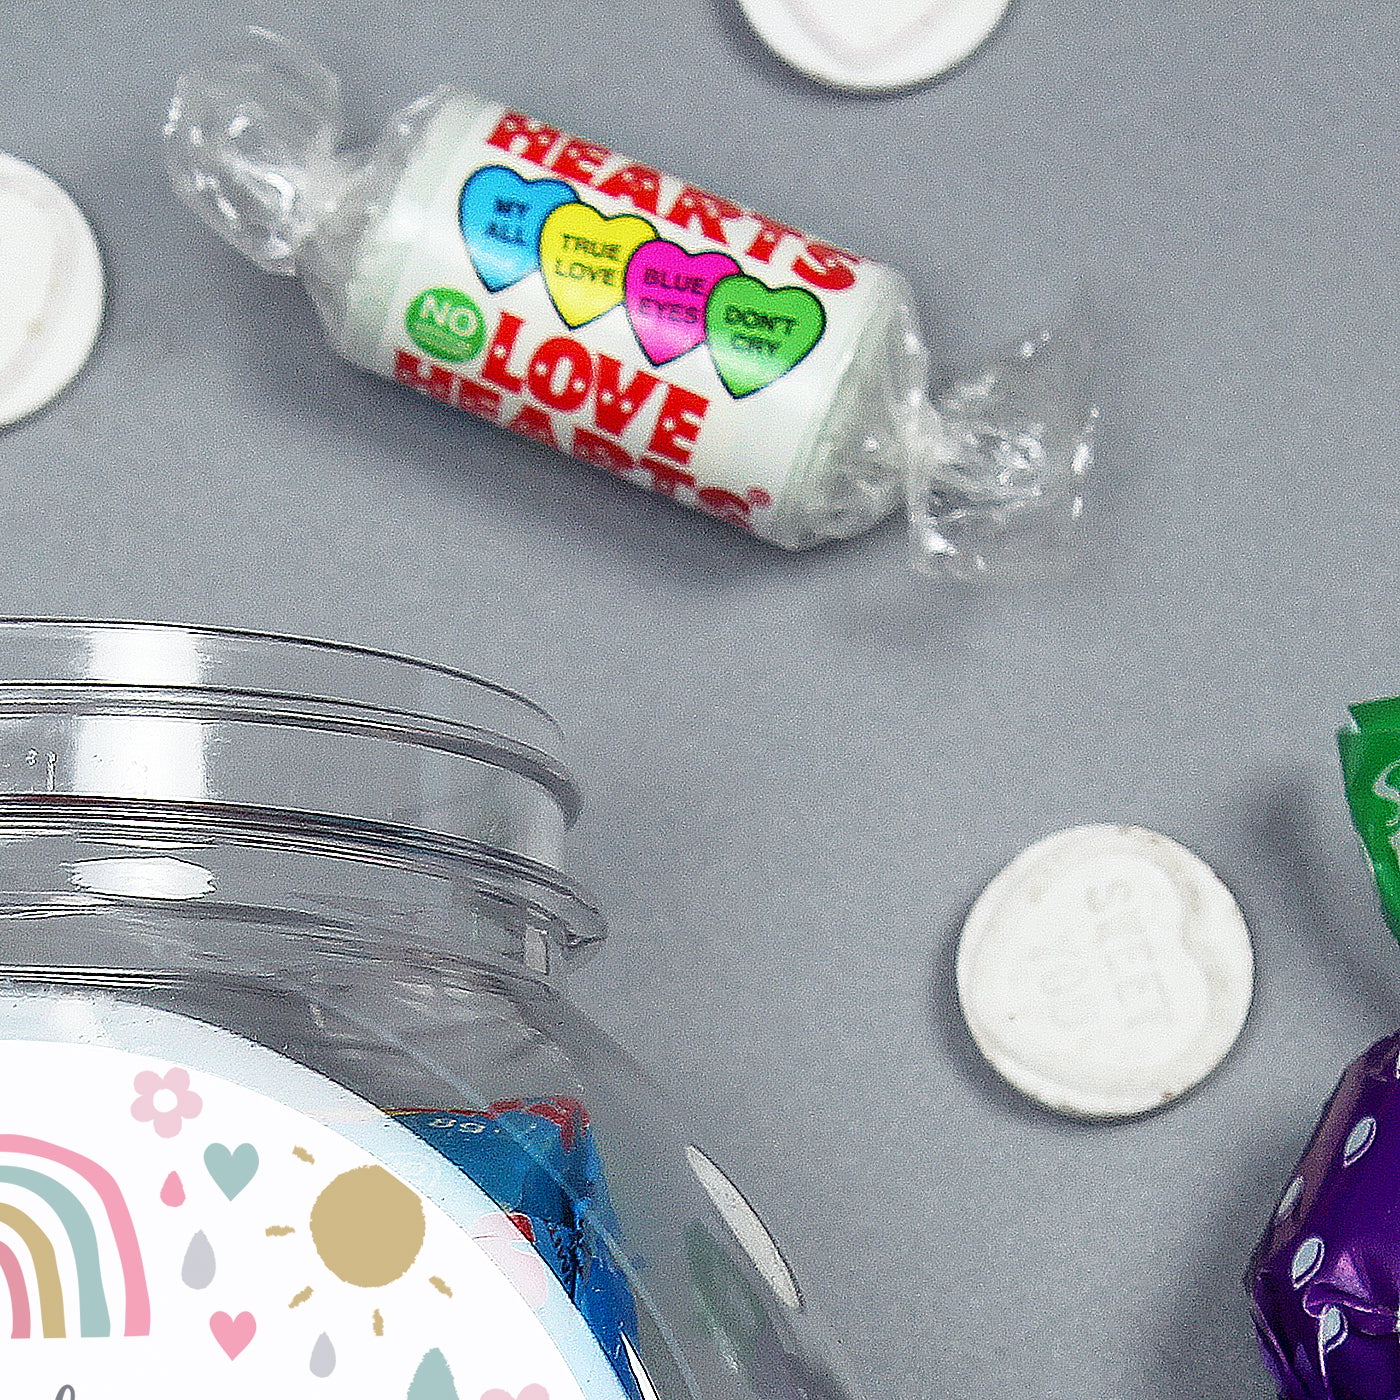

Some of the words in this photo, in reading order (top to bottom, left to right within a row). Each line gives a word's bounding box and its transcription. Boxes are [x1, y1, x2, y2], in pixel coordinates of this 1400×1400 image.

[487, 110, 860, 290] HEARTS
[561, 233, 622, 260] TRUE
[555, 260, 616, 286] LOVE
[643, 268, 706, 295] BLUE
[419, 291, 478, 340] NO
[639, 297, 698, 324] EYES
[724, 304, 796, 334] DON'T
[731, 333, 782, 358] CRY
[480, 310, 709, 464] LOVE
